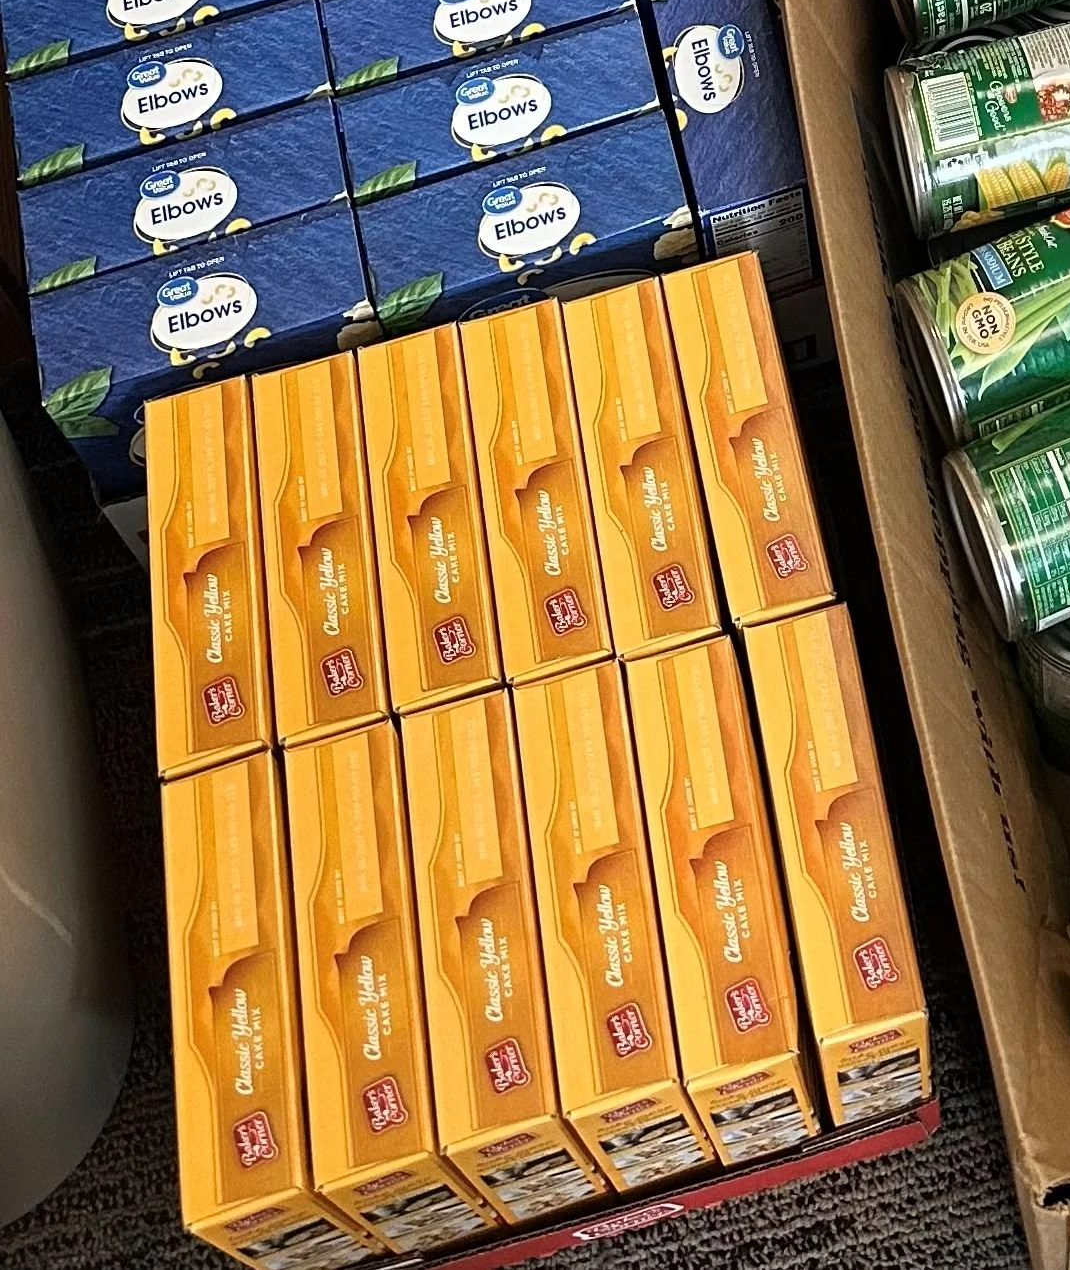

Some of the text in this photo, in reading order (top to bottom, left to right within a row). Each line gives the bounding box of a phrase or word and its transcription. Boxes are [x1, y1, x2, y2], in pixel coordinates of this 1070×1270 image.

[137, 82, 209, 115] Elbows
[467, 95, 539, 130] Elbows
[150, 191, 224, 225] Elbows
[494, 204, 567, 241] Elbows
[711, 204, 769, 225] Nutrition
[980, 249, 1008, 284] SODIUM
[167, 298, 243, 333] Elbows
[971, 308, 990, 340] GMO
[982, 304, 1000, 336] NON
[715, 860, 735, 909] Yellow
[840, 821, 871, 923] Classic Yellow
[859, 838, 877, 900] CAKE MIX
[599, 883, 626, 987] Classic Yellow
[616, 901, 633, 963] CAKE MIX
[377, 972, 389, 996] MIX
[479, 916, 505, 1022] Classic Yellow
[857, 949, 876, 992] Baker's
[875, 943, 897, 986] Corner
[358, 955, 382, 1061] Classic Yellow
[748, 982, 769, 1024] Corner
[254, 1034, 265, 1070] CAKE
[612, 1013, 630, 1057] Baker's
[234, 1038, 255, 1095] Classic
[235, 1119, 253, 1165] Baker's
[256, 1119, 276, 1163] Corner
